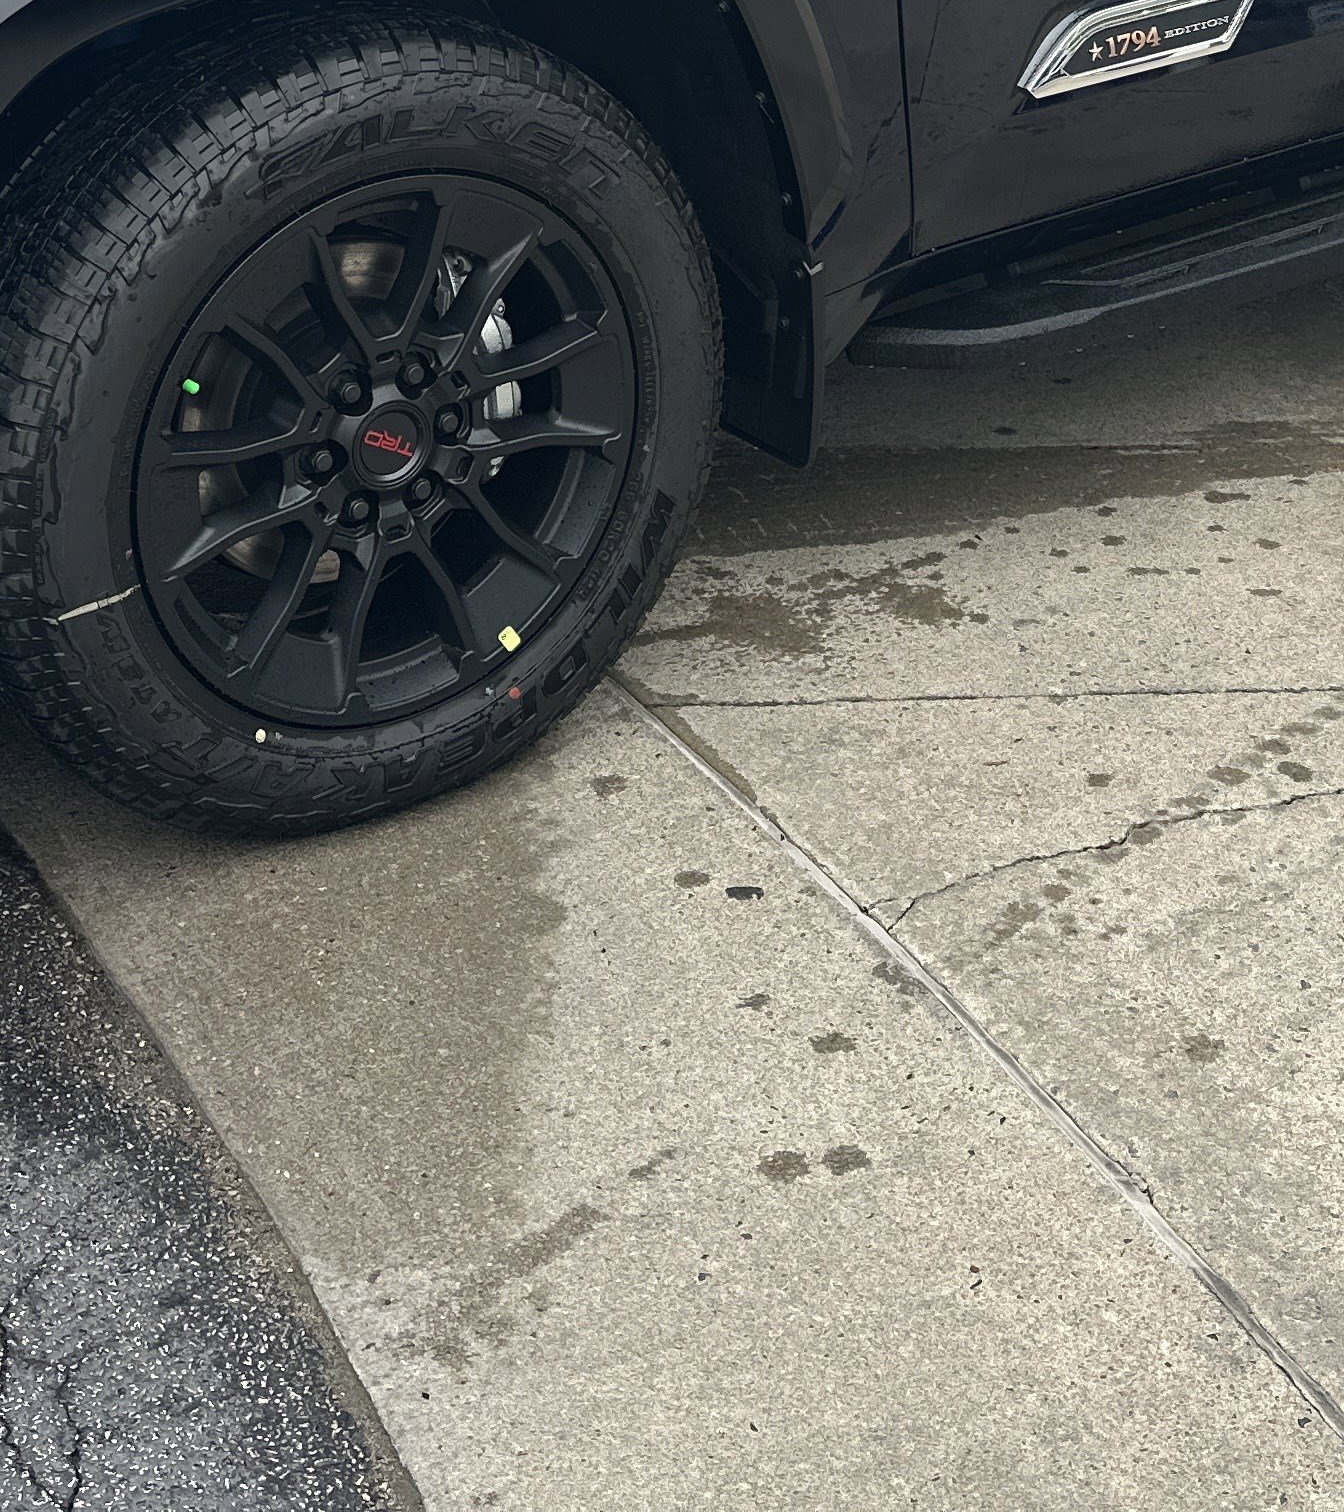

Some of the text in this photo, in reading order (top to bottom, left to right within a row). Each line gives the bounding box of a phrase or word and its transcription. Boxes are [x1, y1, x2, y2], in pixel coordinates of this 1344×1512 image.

[1106, 15, 1230, 58] 1794 EDITION
[244, 104, 624, 200] FALKEN
[364, 430, 413, 458] TRD
